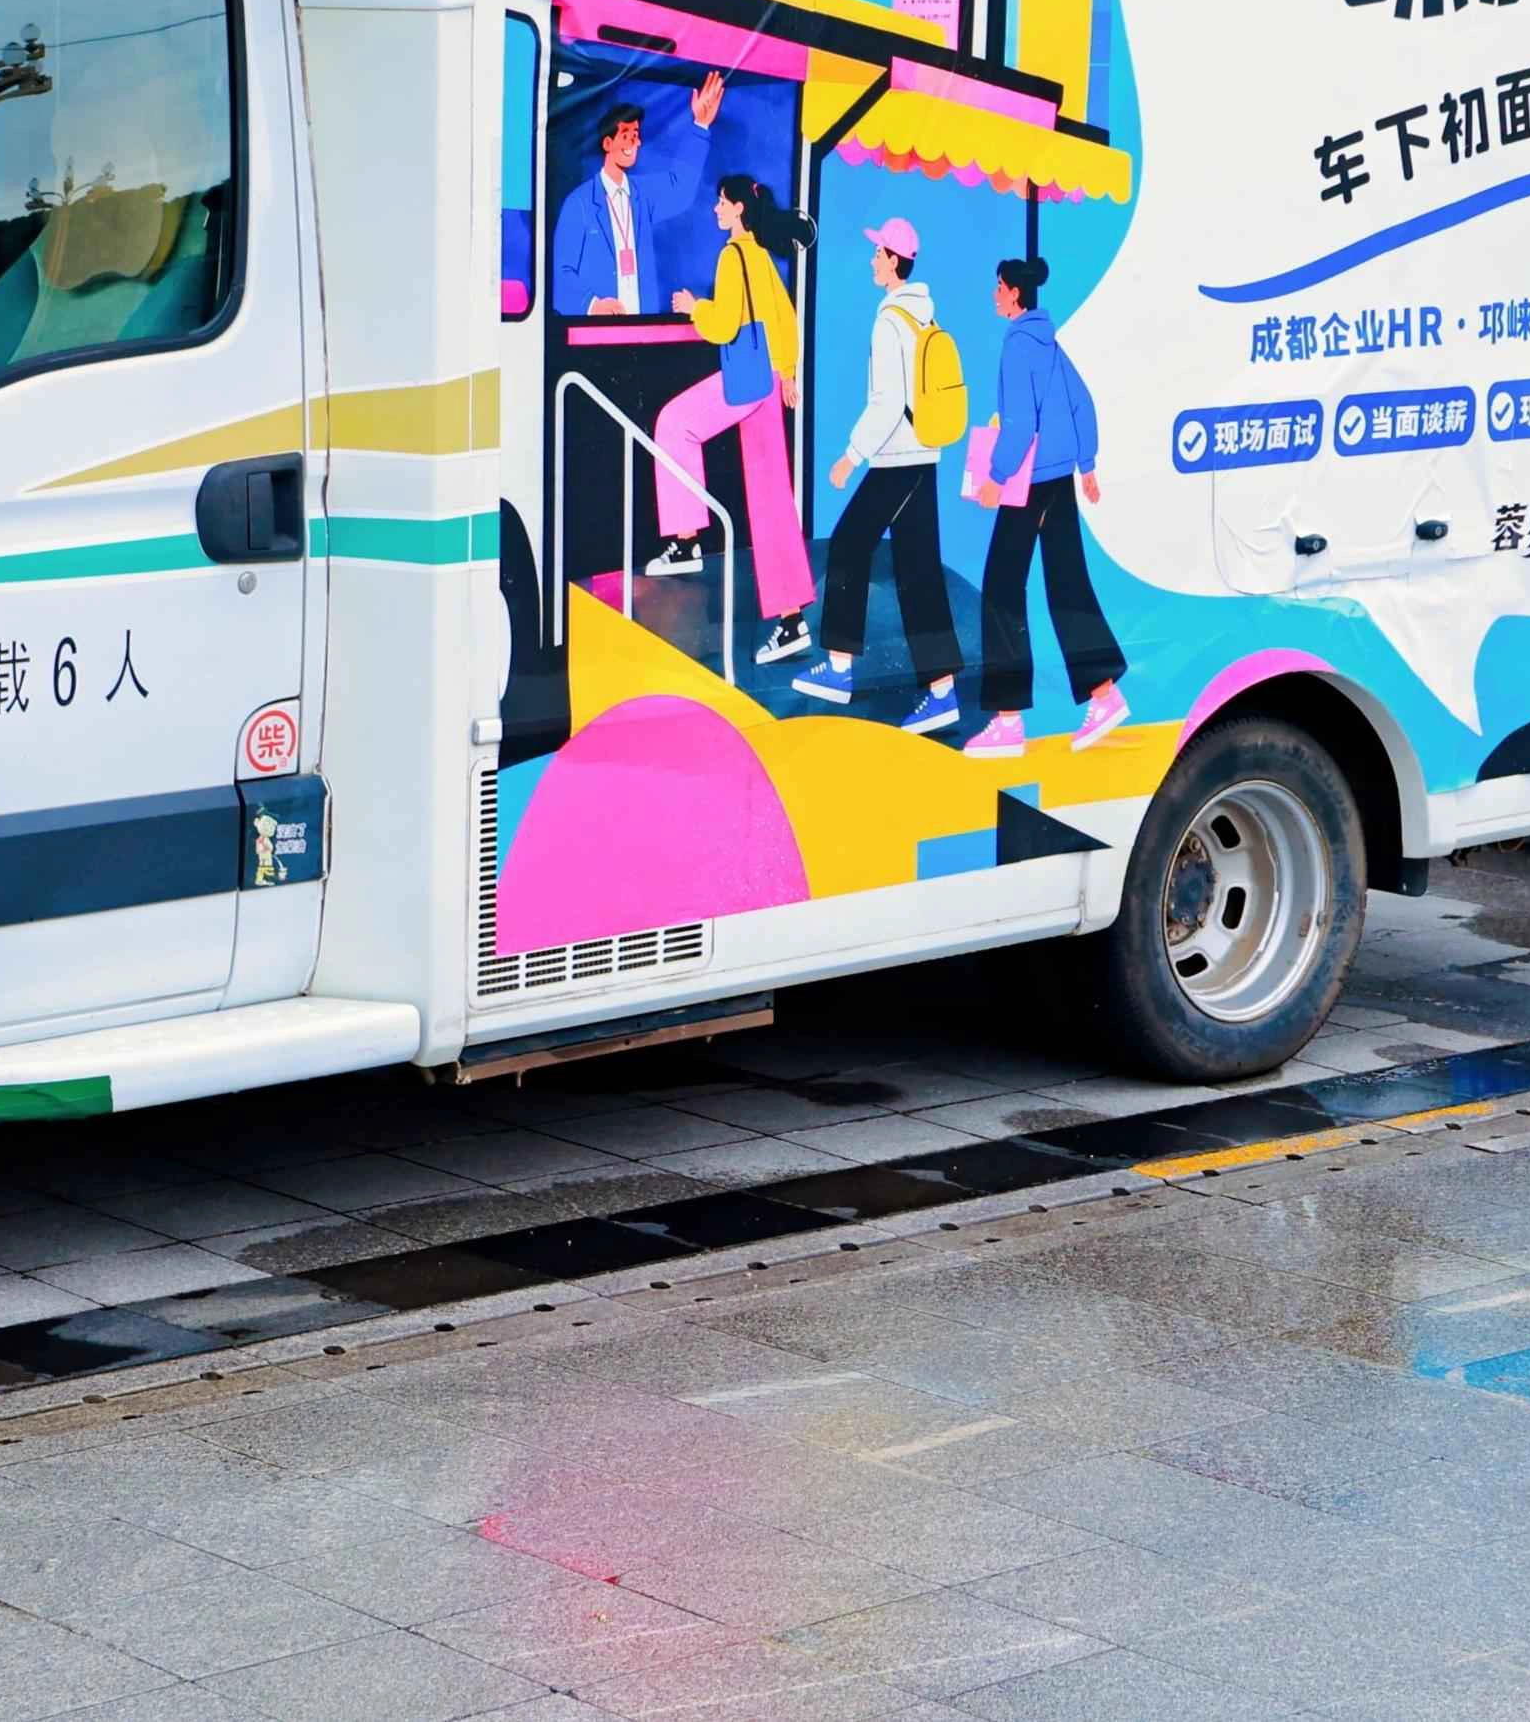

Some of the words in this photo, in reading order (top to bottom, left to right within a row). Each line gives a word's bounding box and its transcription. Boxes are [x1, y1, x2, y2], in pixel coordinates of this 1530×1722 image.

[1214, 415, 1316, 455] 现场面试
[1371, 397, 1469, 441] 当面谈薪
[257, 723, 286, 759] 柴
